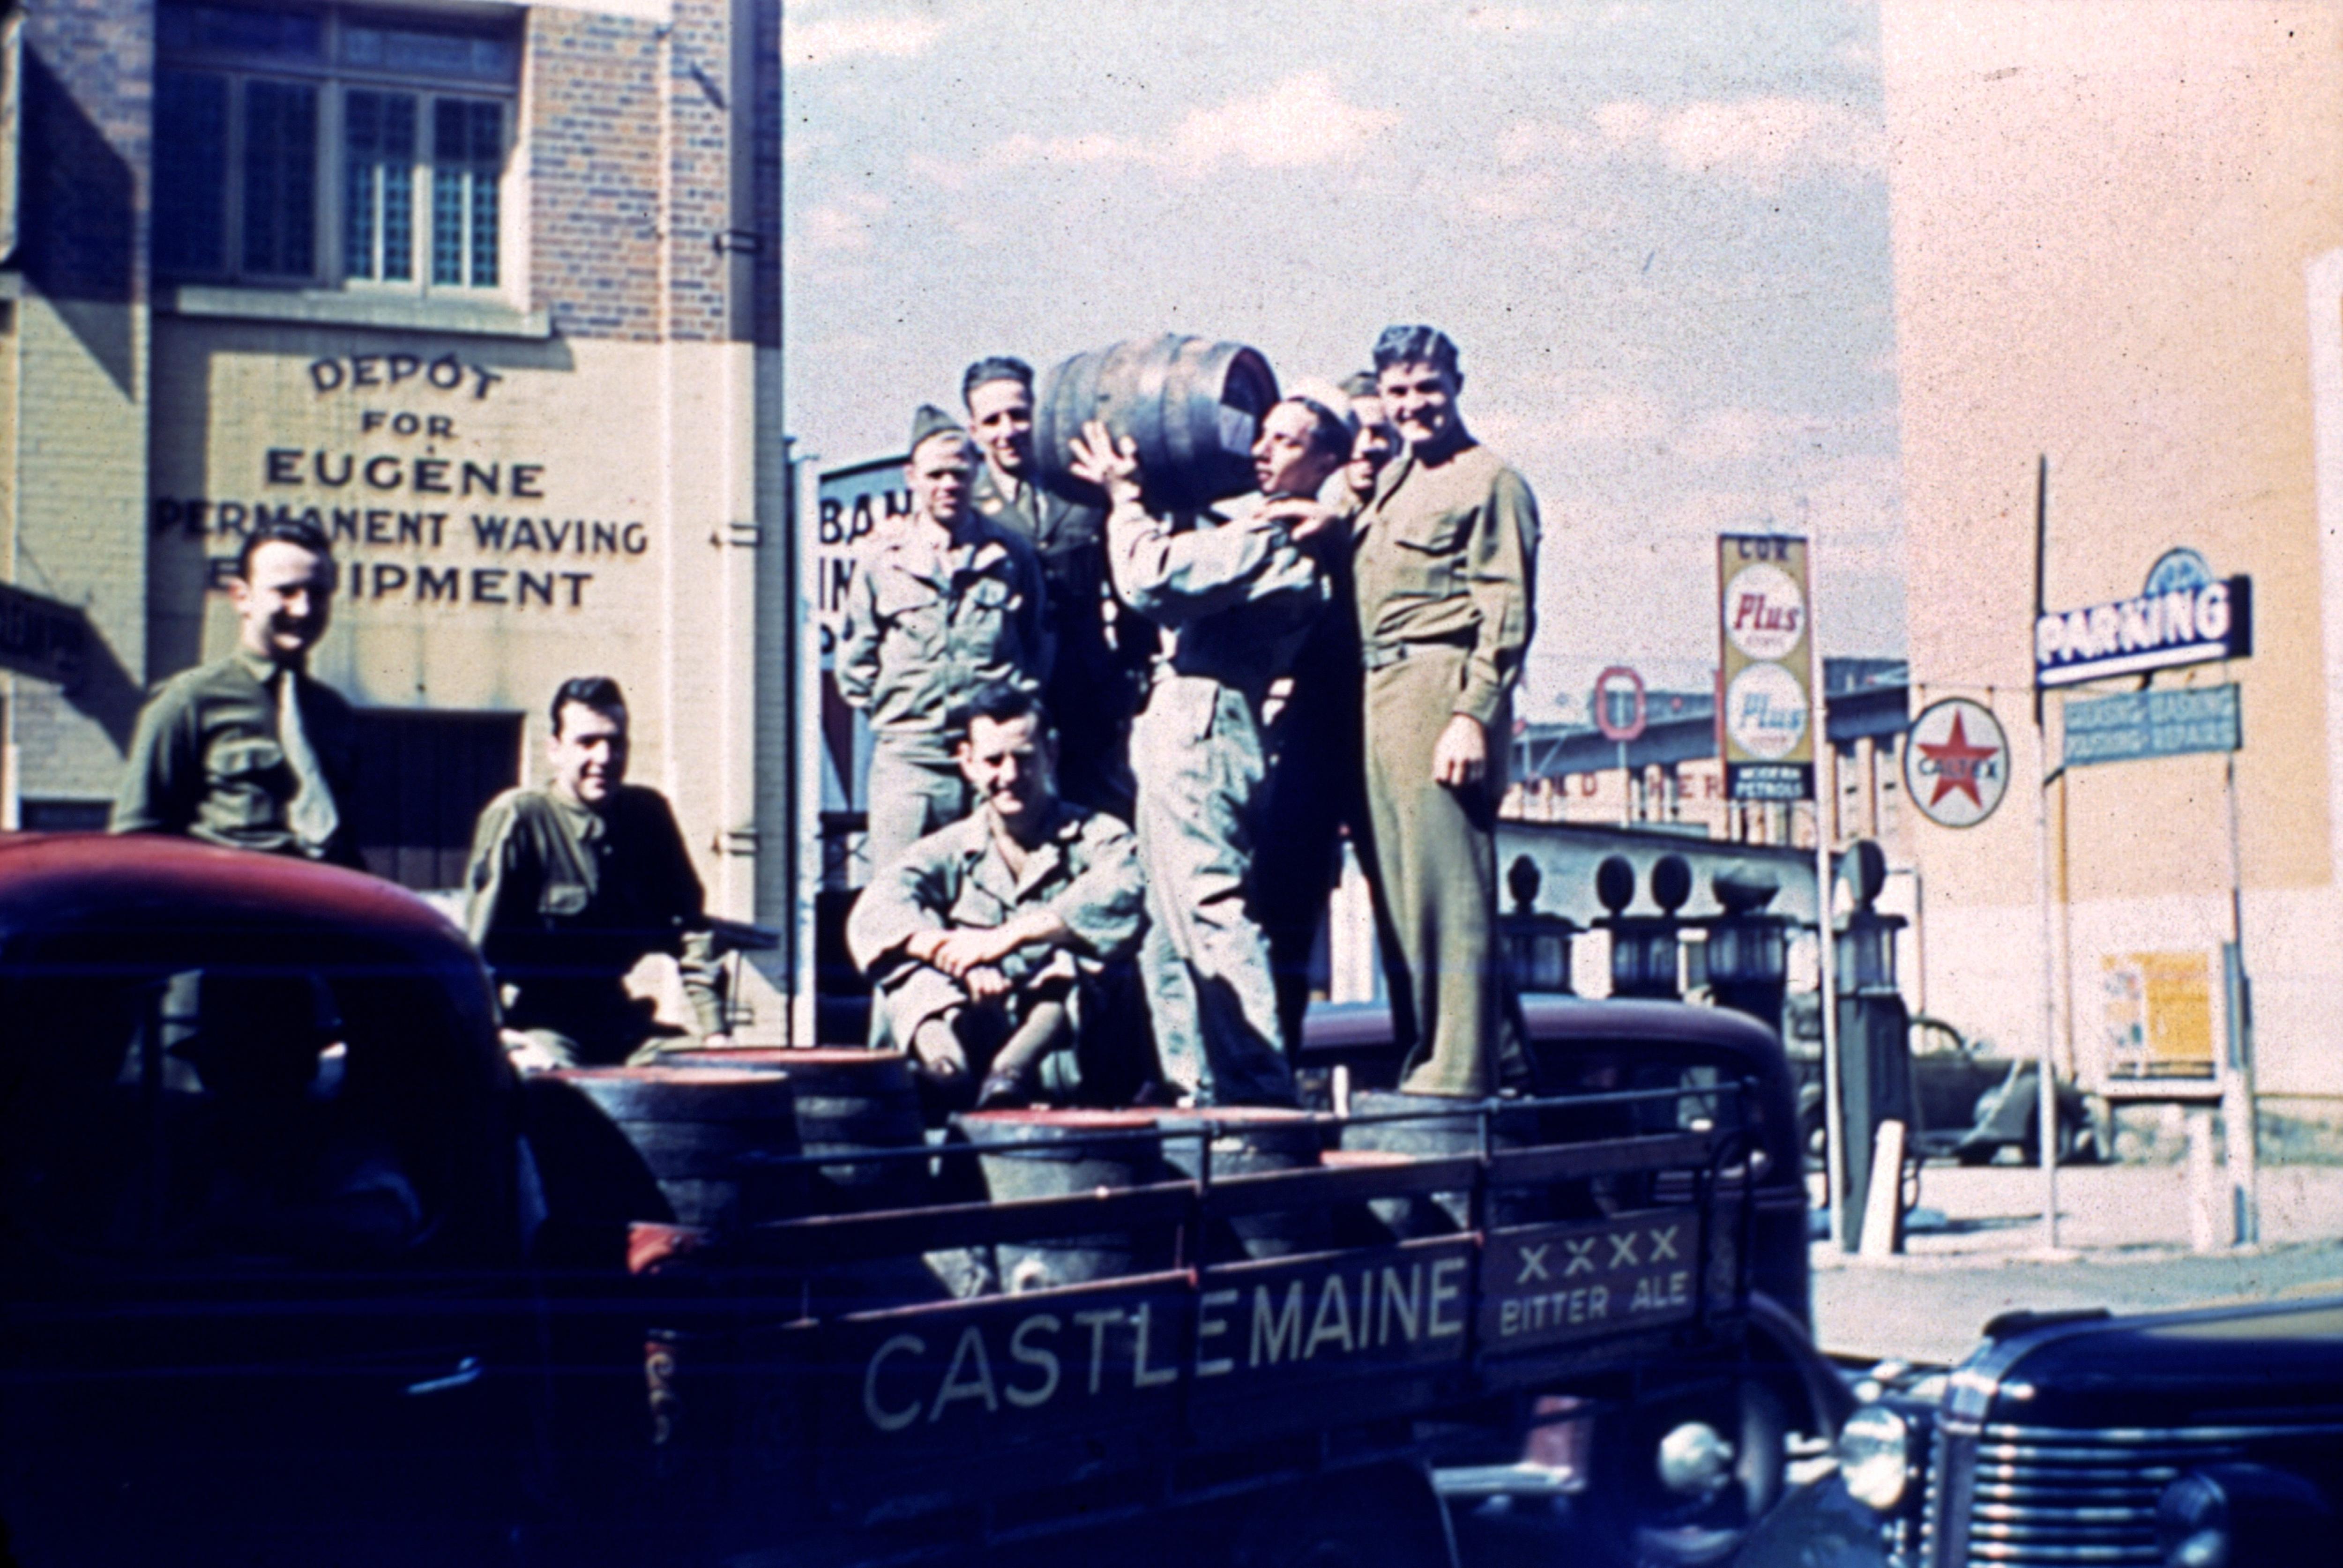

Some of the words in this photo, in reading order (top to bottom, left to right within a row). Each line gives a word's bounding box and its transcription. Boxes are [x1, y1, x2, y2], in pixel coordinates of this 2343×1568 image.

[360, 410, 456, 439] FOR
[470, 513, 649, 555] WAVING
[209, 557, 594, 607] EIPMENT
[1734, 592, 1800, 632] Plus
[2036, 583, 2230, 665] PARKING
[1739, 693, 1806, 731] Plus
[1500, 1285, 1609, 1337] BITTER
[1631, 1271, 1688, 1310] ALE
[863, 1257, 1467, 1431] CASTLEMAINE
